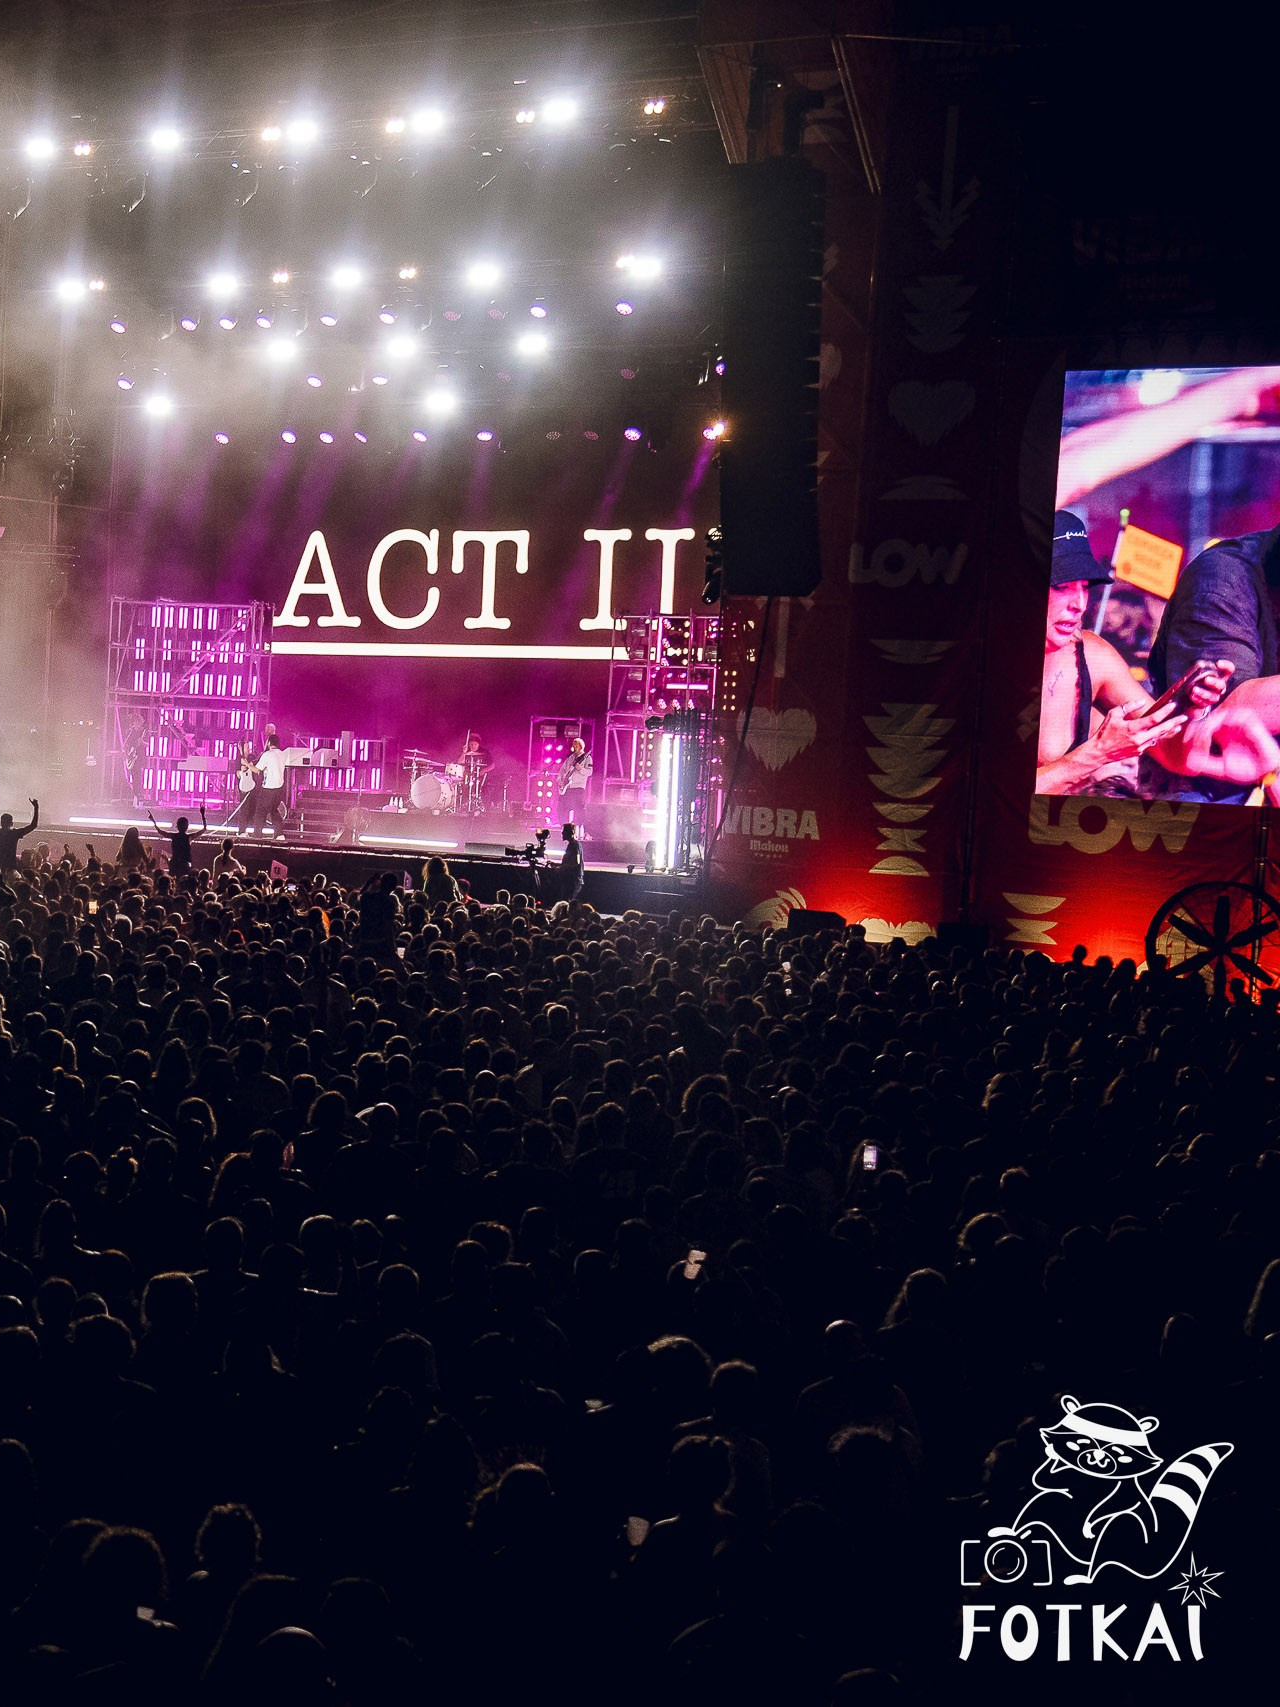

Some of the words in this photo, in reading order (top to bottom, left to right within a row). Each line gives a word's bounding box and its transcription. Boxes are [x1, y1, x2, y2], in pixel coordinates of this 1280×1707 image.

[272, 528, 530, 631] ACT
[579, 528, 696, 632] II
[848, 538, 969, 588] LOW
[723, 804, 820, 841] VIBRA
[749, 839, 789, 853] Mahou
[1028, 793, 1201, 855] LOW
